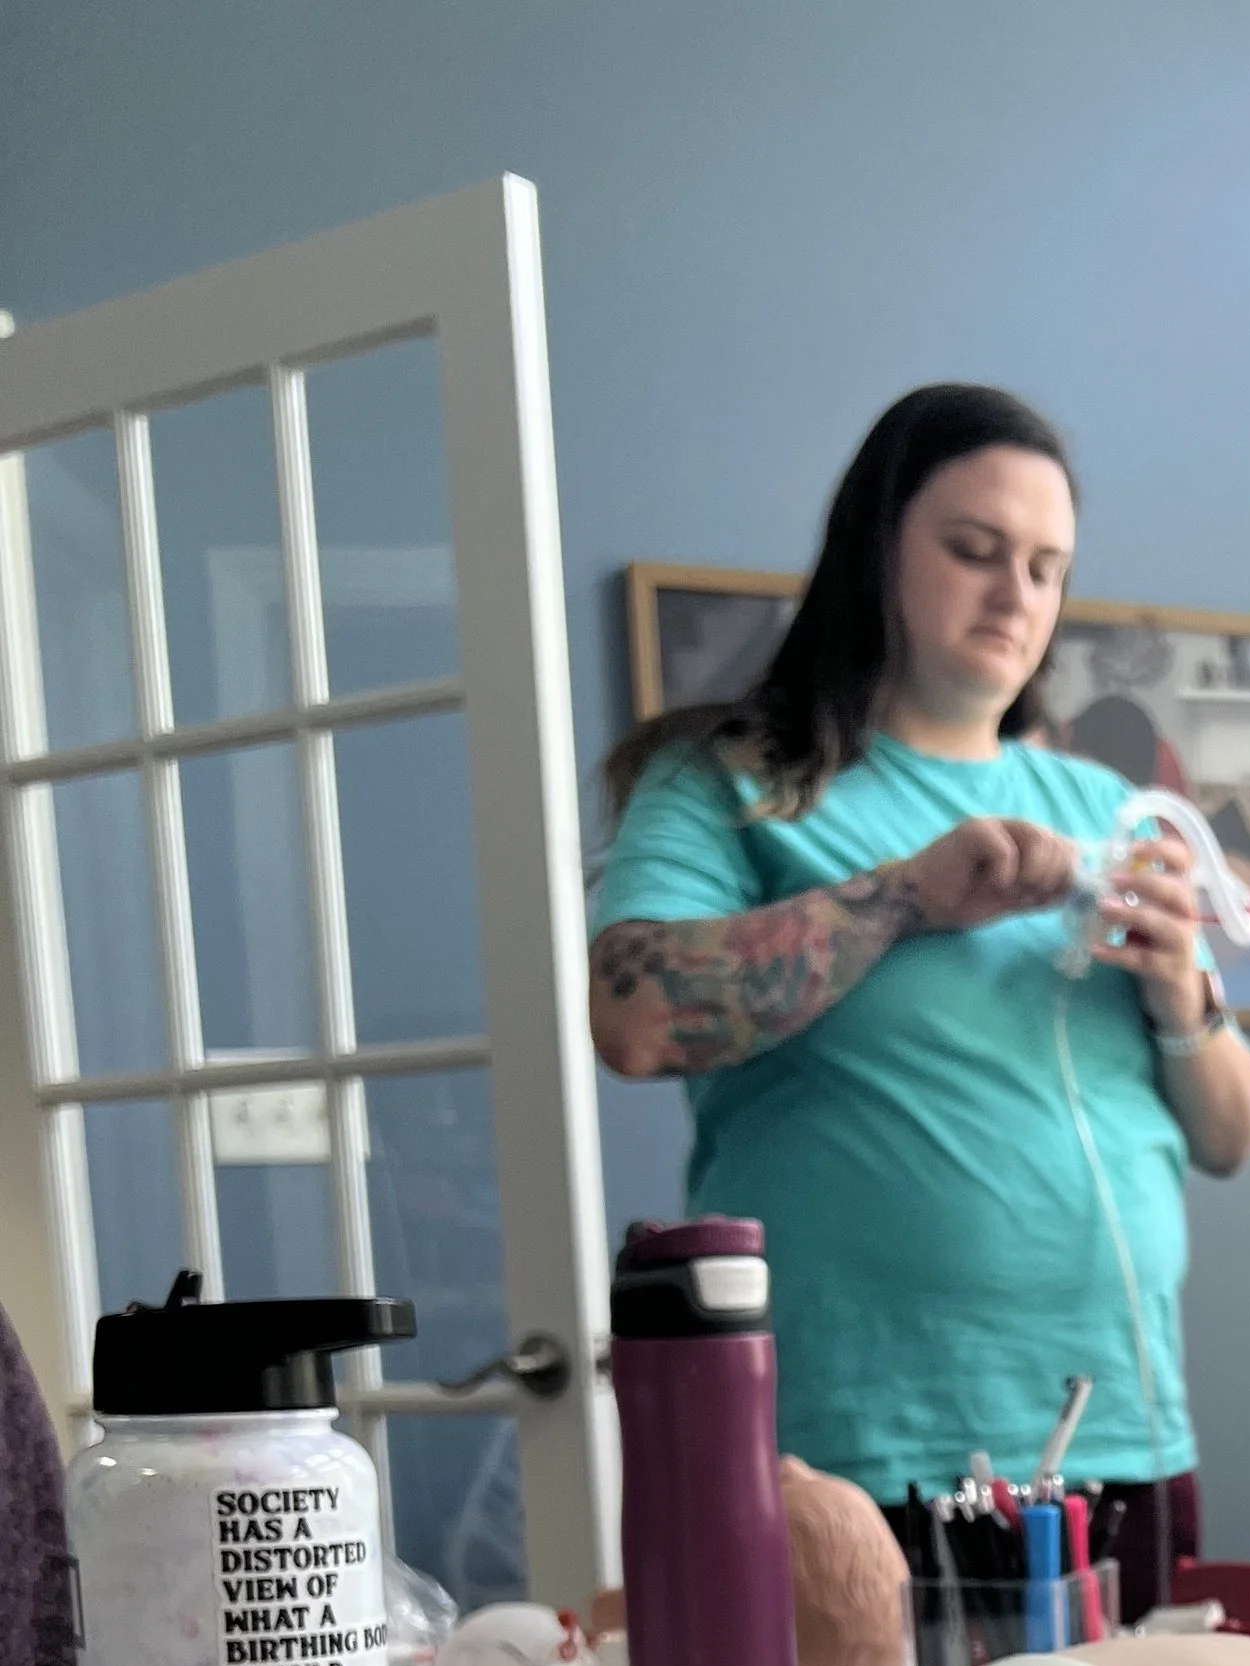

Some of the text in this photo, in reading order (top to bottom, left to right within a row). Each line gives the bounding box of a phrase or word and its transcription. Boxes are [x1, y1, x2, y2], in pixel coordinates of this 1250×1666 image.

[217, 1487, 339, 1516] SOCIETY
[219, 1517, 313, 1543] HAS A
[221, 1541, 366, 1573] DISTORTED
[223, 1573, 339, 1602] VIEW OF
[224, 1604, 336, 1634] WHAT A
[226, 1624, 388, 1664] BIRTHING BOD
